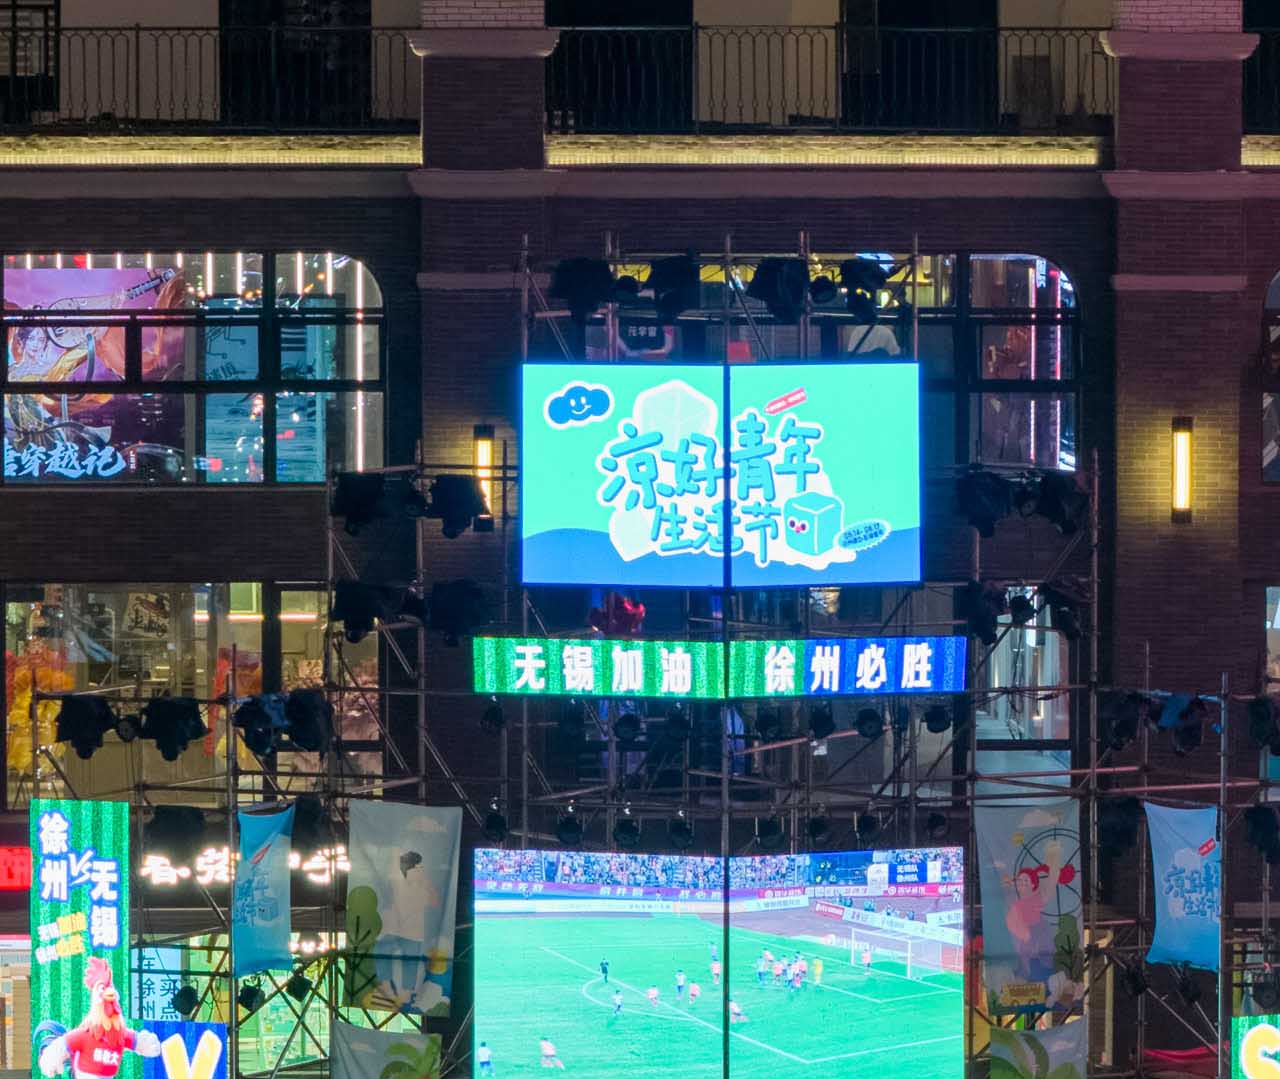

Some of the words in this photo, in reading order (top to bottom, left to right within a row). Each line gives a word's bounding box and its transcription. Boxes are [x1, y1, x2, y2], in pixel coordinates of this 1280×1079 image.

[602, 412, 821, 510] 凉好青年
[650, 500, 782, 564] 生活节
[514, 645, 692, 693] 无锡加油
[763, 643, 932, 692] 徐州必胜
[39, 812, 68, 901] 徐州
[90, 860, 118, 948] 无锡
